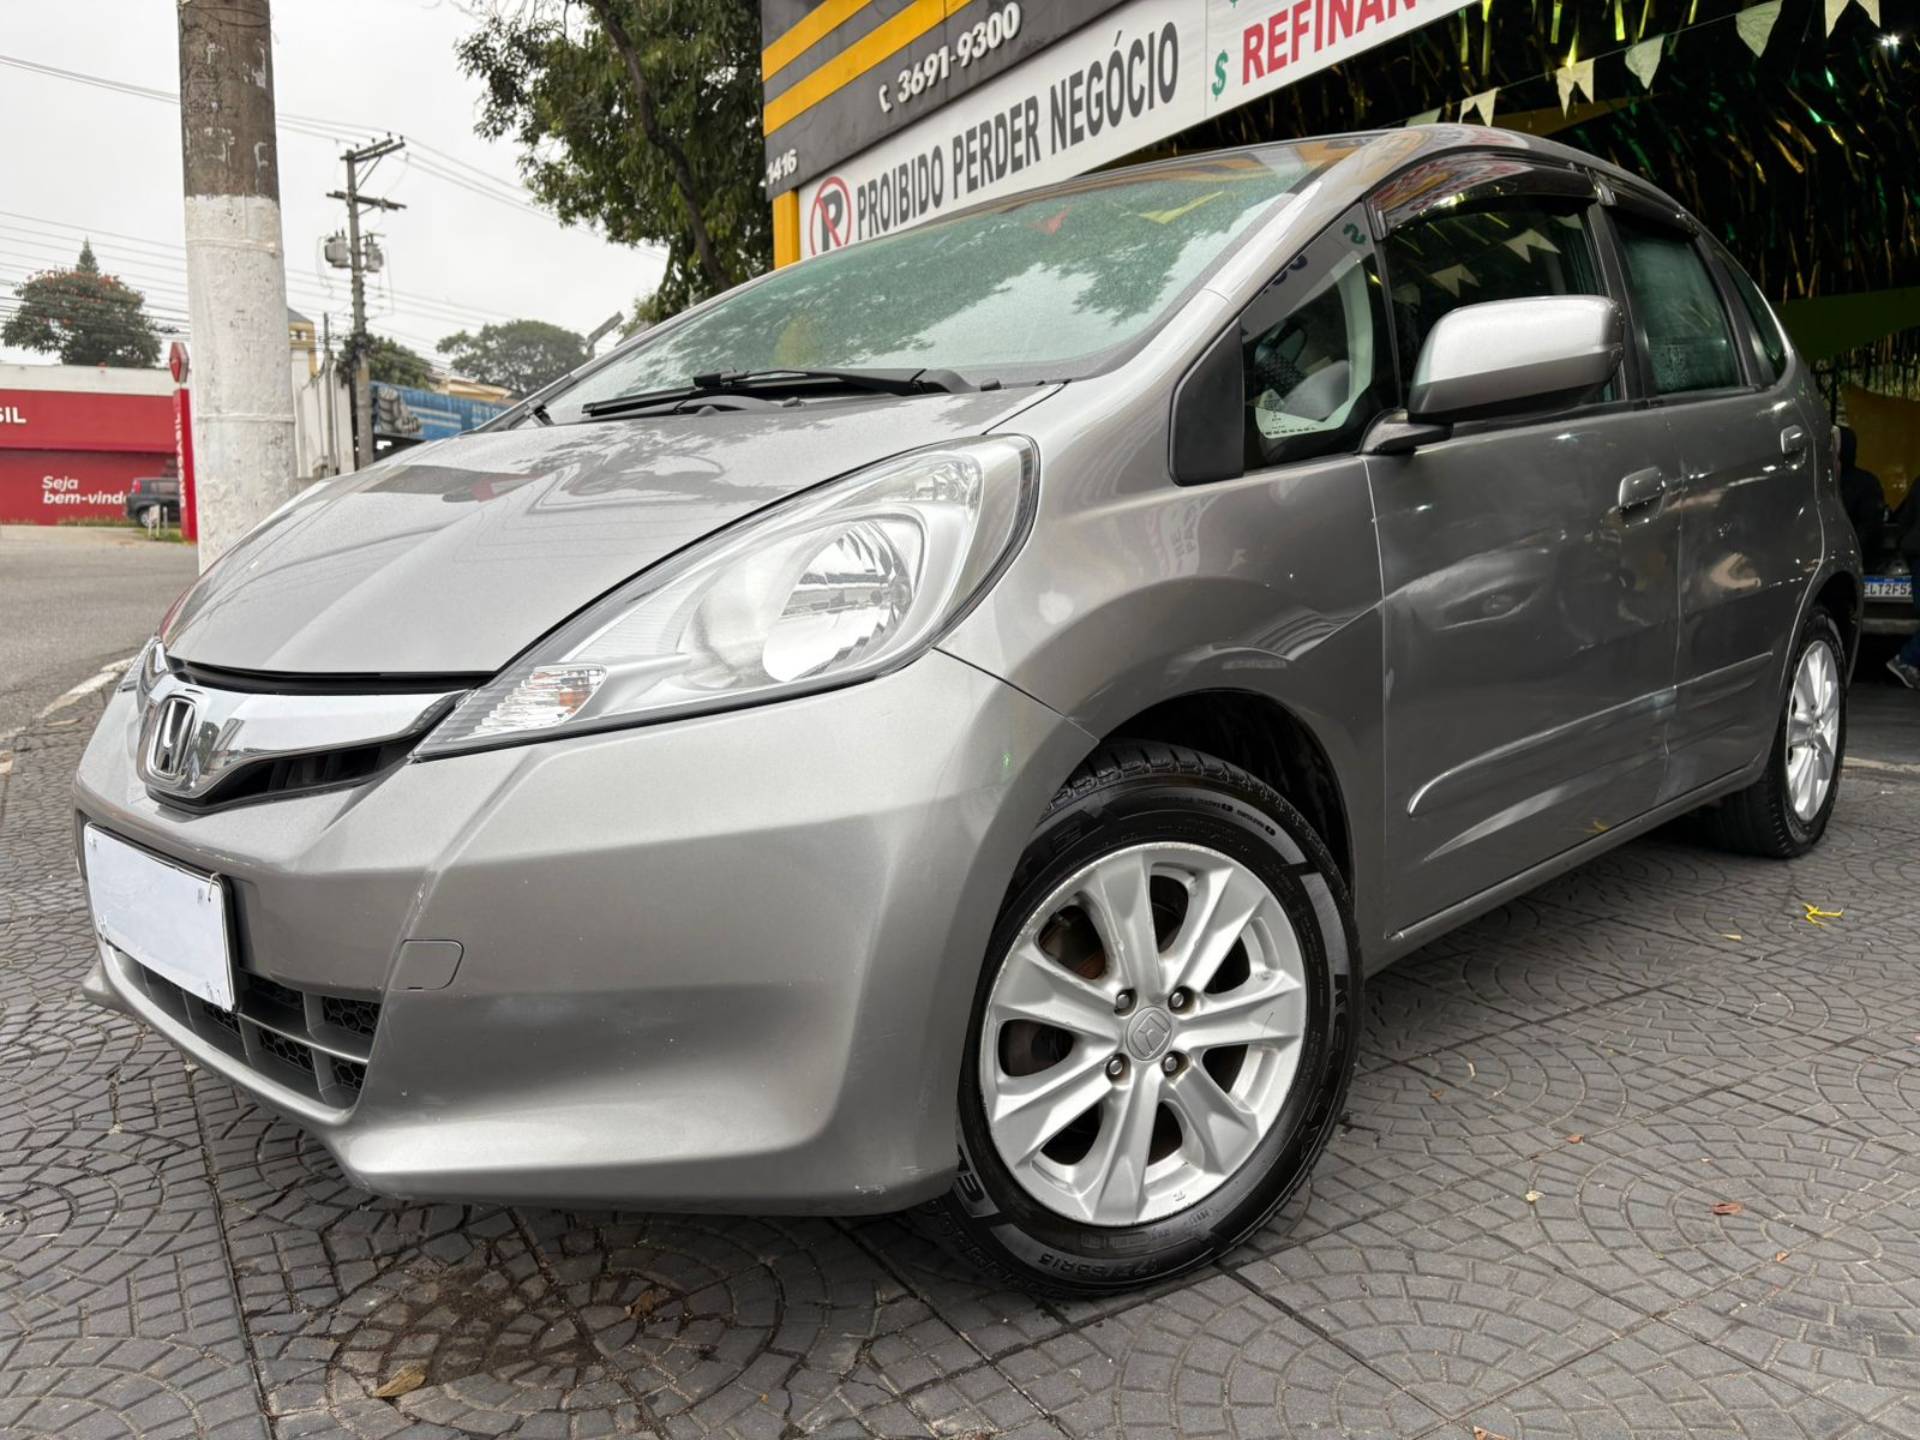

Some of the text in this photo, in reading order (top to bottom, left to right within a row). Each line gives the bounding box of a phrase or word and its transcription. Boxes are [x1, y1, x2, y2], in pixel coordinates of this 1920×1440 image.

[897, 1, 1022, 103] 3691-9300
[1242, 0, 1417, 86] REFINA
[857, 144, 945, 240] PROIBIDO
[952, 95, 1041, 199] PERDER
[1050, 21, 1179, 155] NEGÓCIO
[766, 148, 798, 185] 1416
[42, 475, 79, 492] Seja
[43, 491, 128, 505] bem-vind
